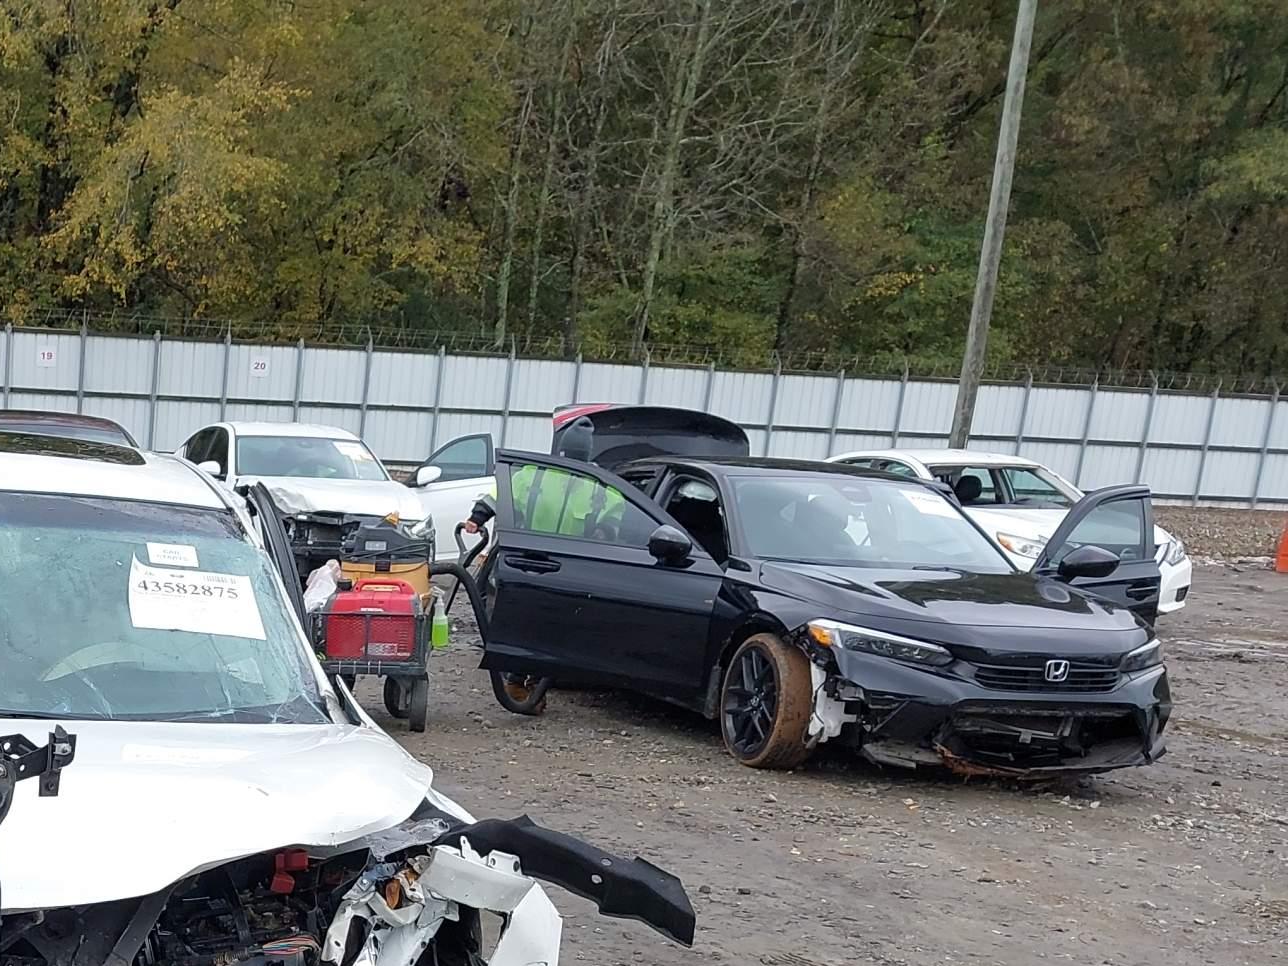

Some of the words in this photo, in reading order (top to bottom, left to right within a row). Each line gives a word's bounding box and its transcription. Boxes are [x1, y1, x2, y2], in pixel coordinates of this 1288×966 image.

[41, 352, 53, 360] 19
[253, 362, 266, 370] 20
[137, 579, 239, 600] 43582875
